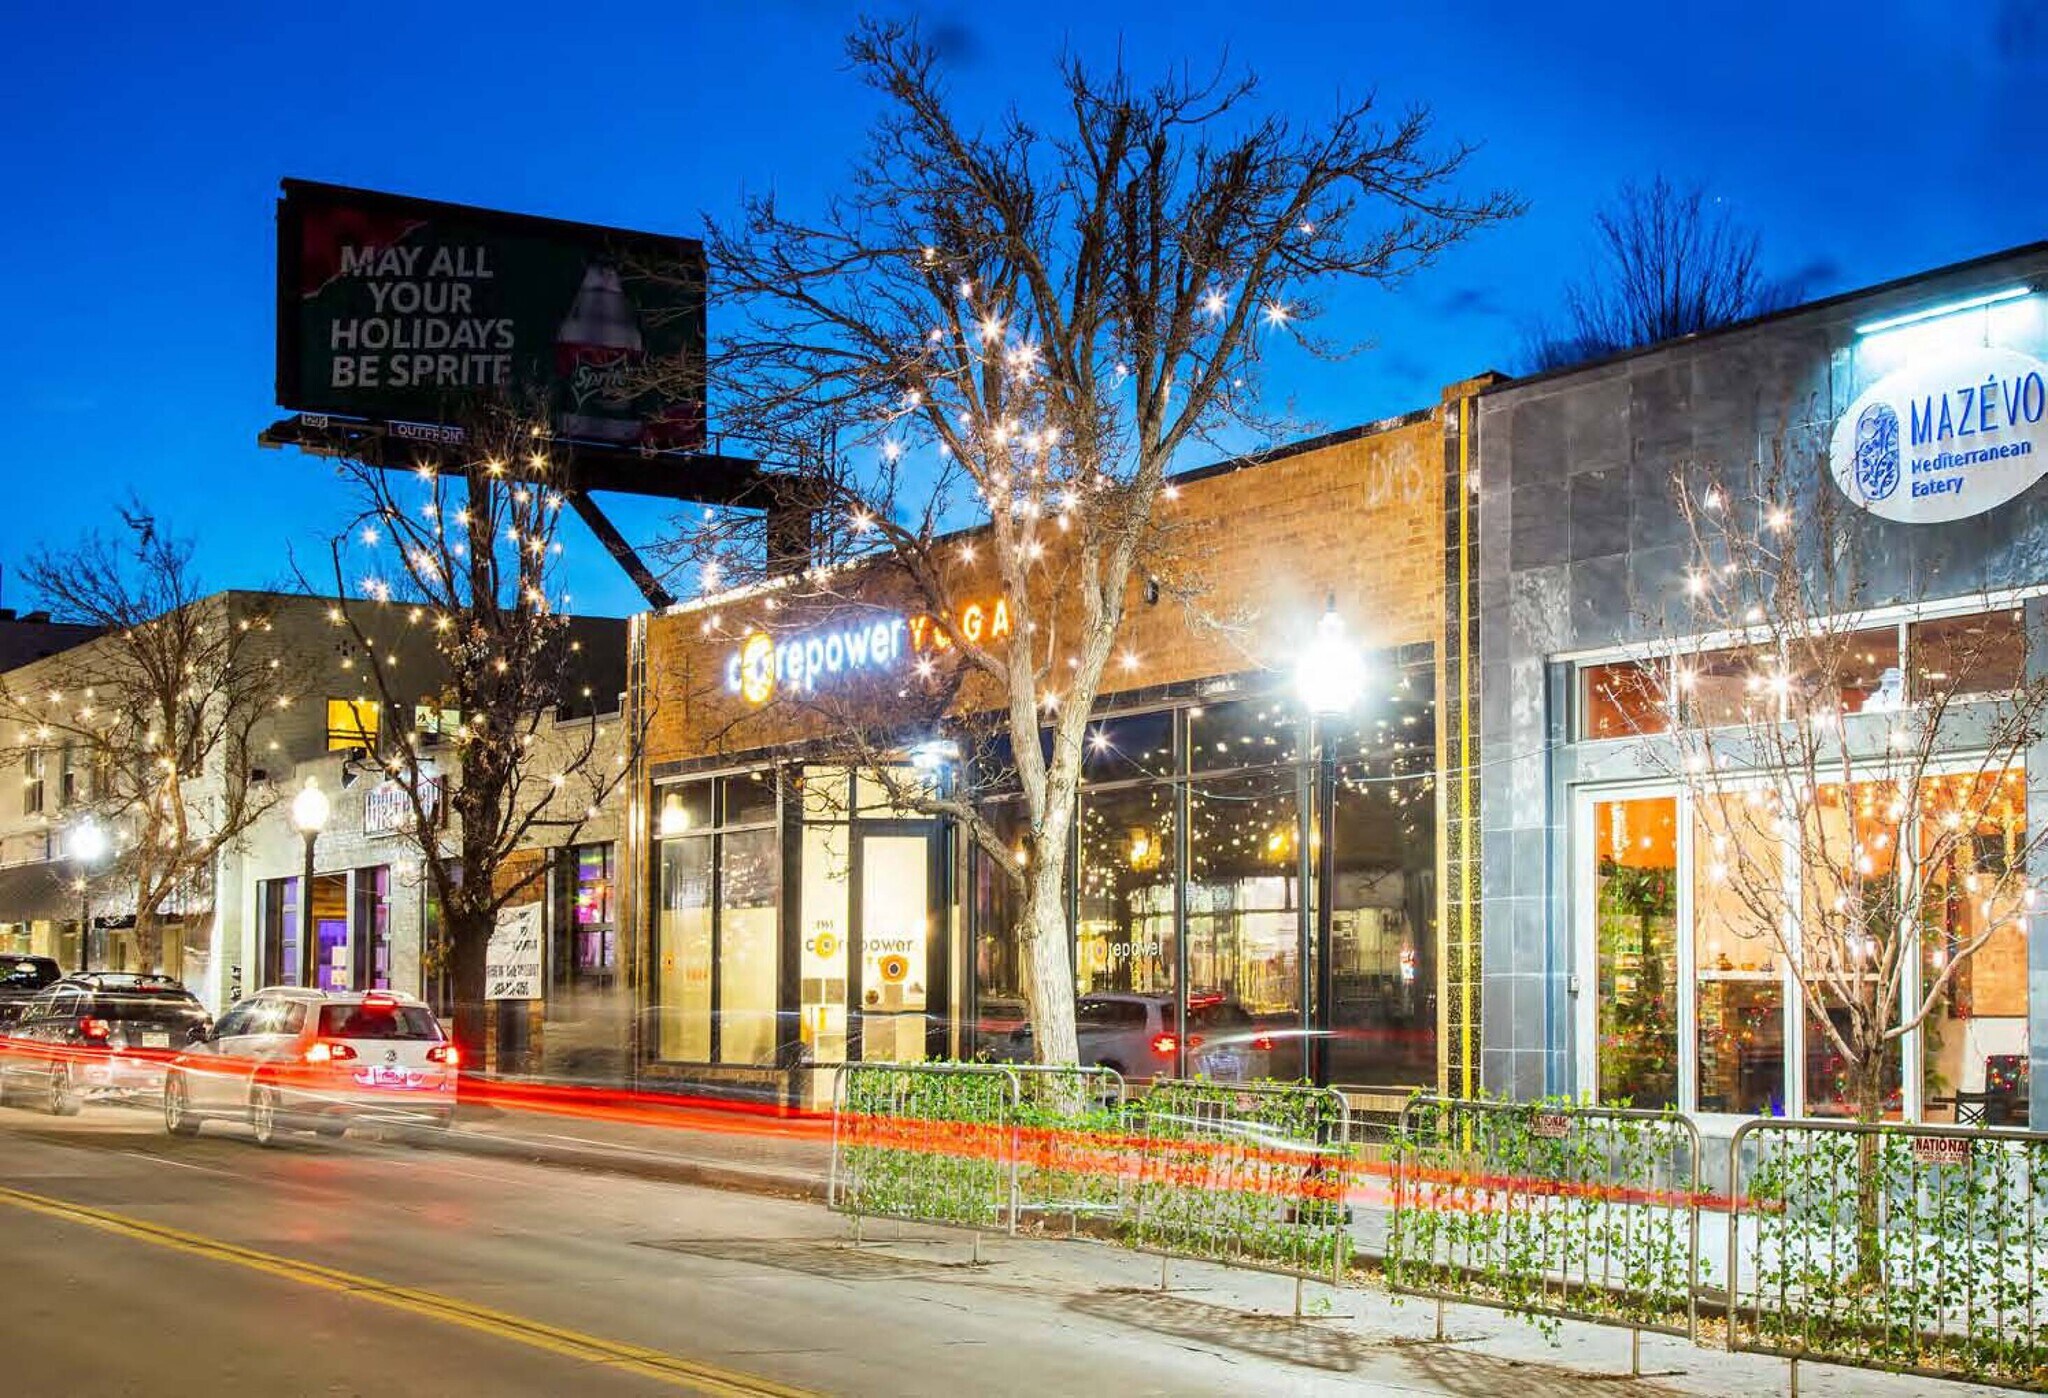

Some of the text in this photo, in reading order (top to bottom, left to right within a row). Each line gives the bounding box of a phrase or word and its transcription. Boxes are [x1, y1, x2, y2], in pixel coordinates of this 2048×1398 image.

[340, 246, 494, 278] MAY ALL
[367, 282, 472, 313] YOUR
[331, 318, 515, 349] HOLIDAYS
[331, 354, 513, 387] BE SPRITE
[1911, 371, 2045, 446] MAZÉVO
[1911, 441, 2032, 474] Mediterranean
[1911, 477, 1964, 498] Eatery
[1915, 1138, 1969, 1154] NATIONAL
